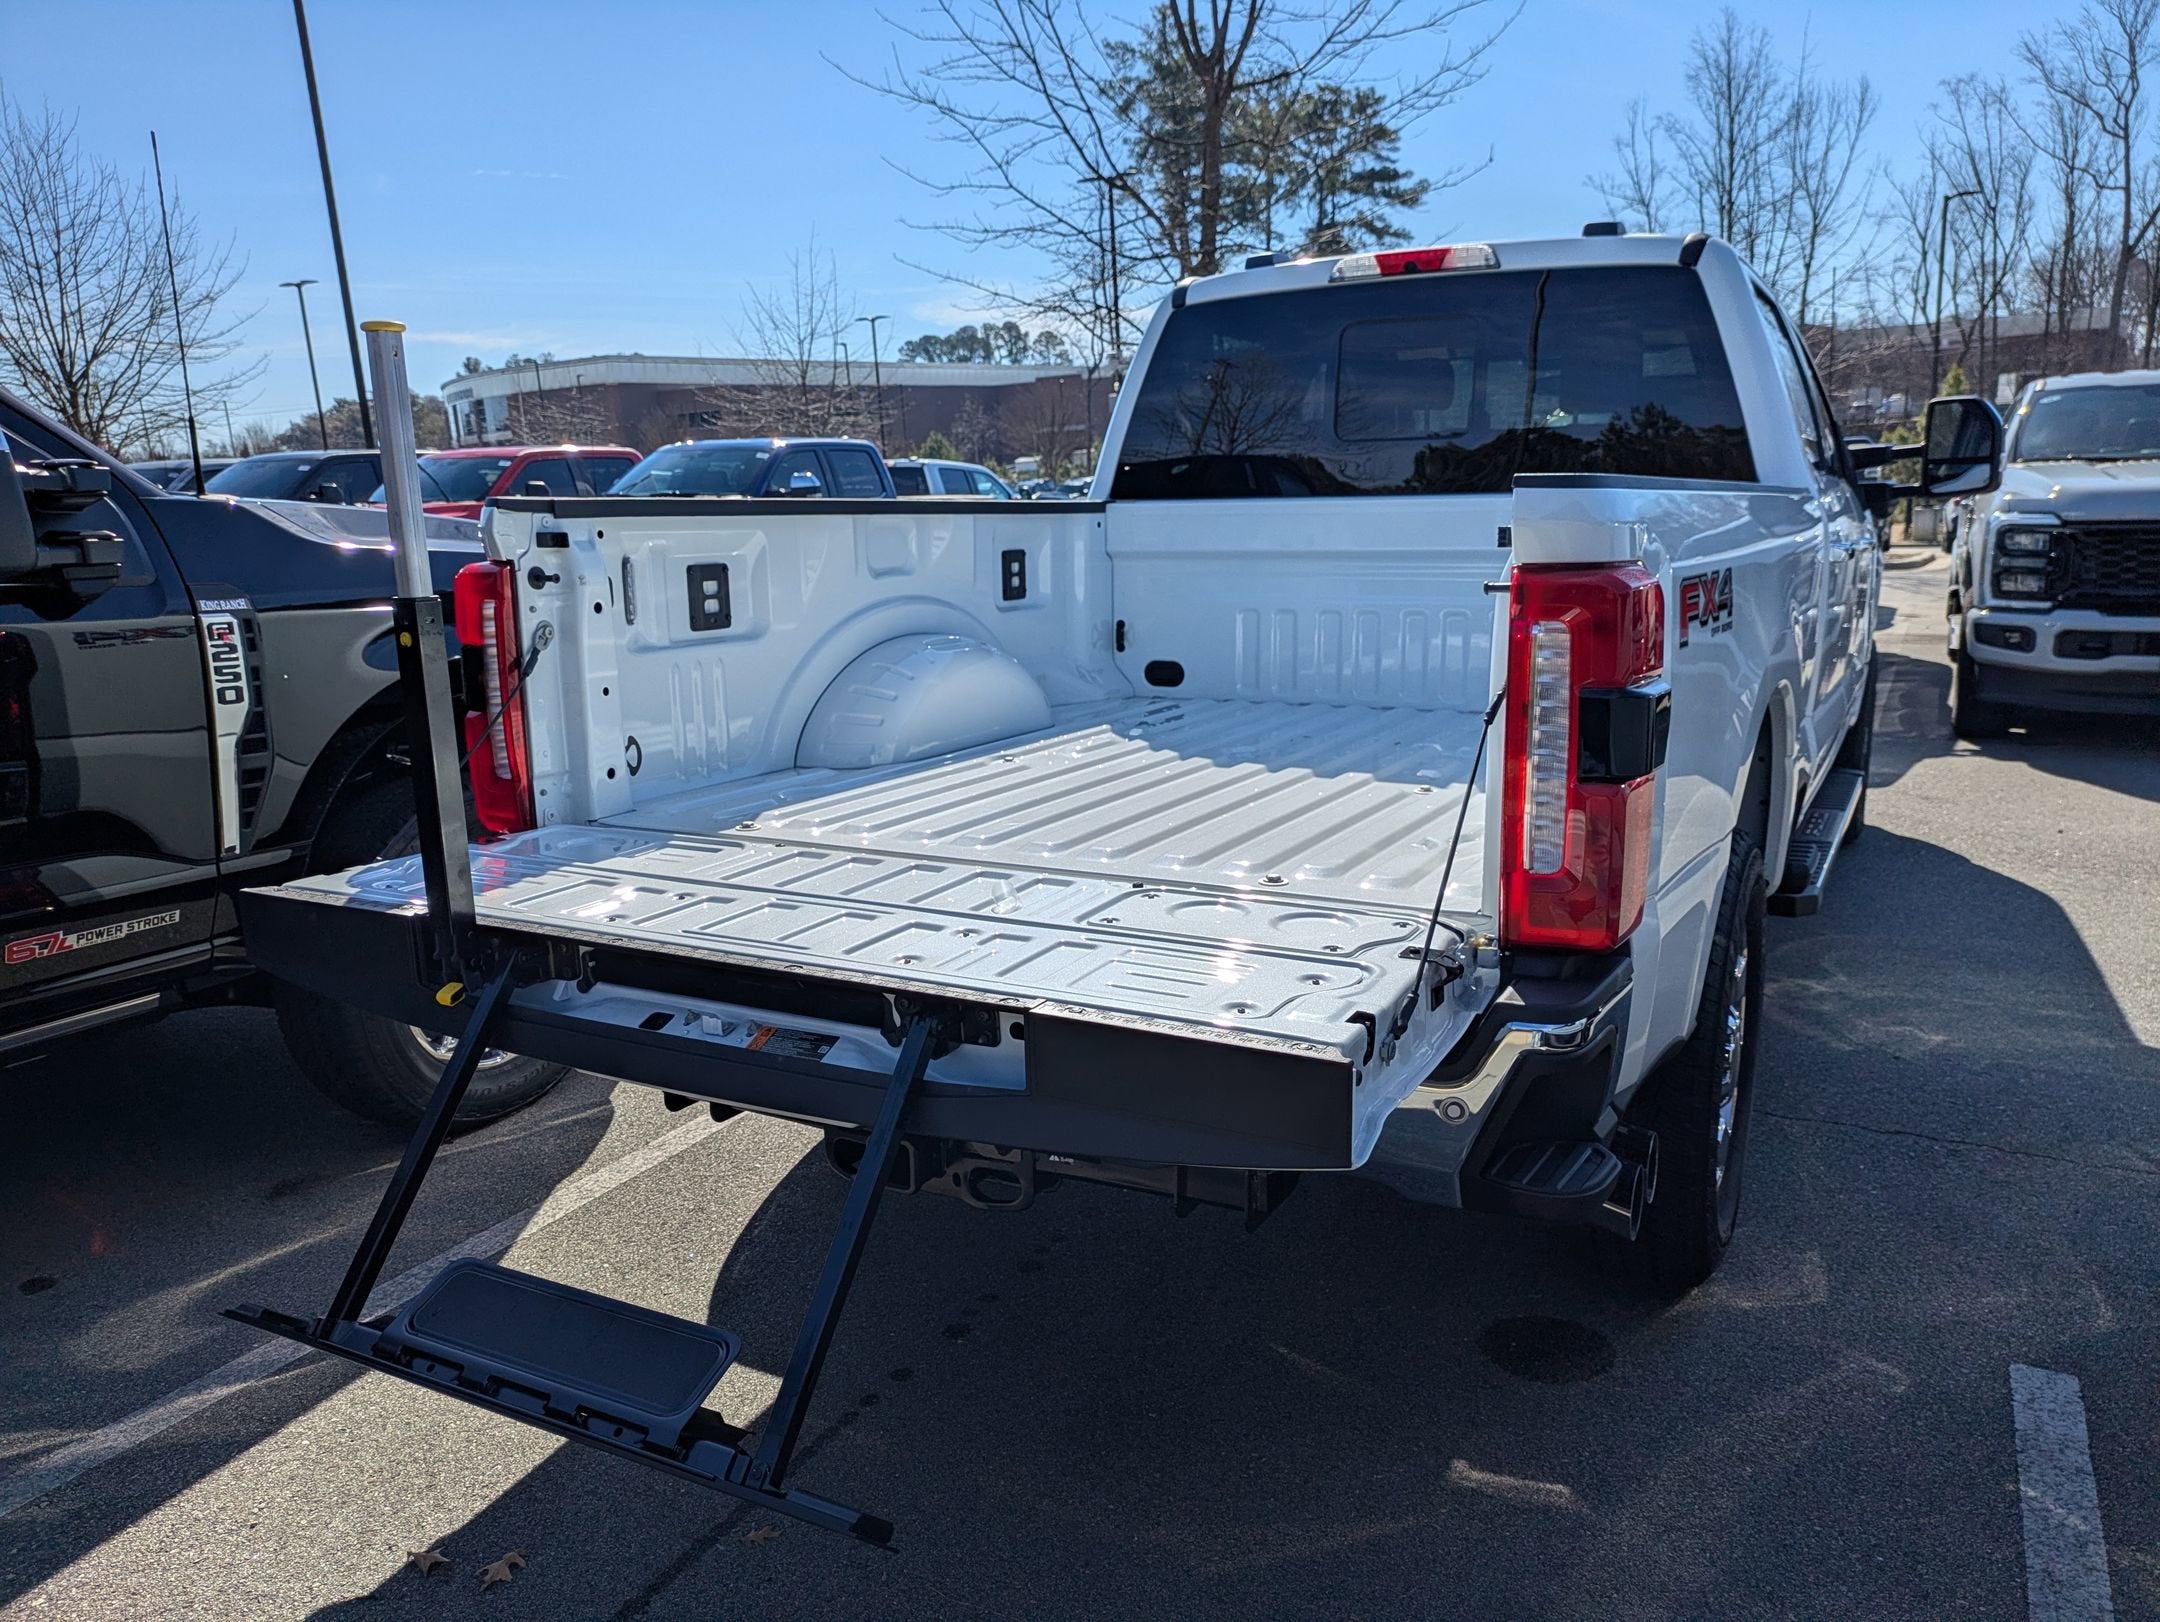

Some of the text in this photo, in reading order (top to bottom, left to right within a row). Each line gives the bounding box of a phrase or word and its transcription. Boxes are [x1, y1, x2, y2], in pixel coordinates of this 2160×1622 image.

[200, 598, 247, 611] KING RANCH
[1680, 566, 1733, 648] FX4
[5, 931, 74, 964] 6.7L
[76, 924, 123, 944] POWER
[127, 912, 177, 932] STROKE
